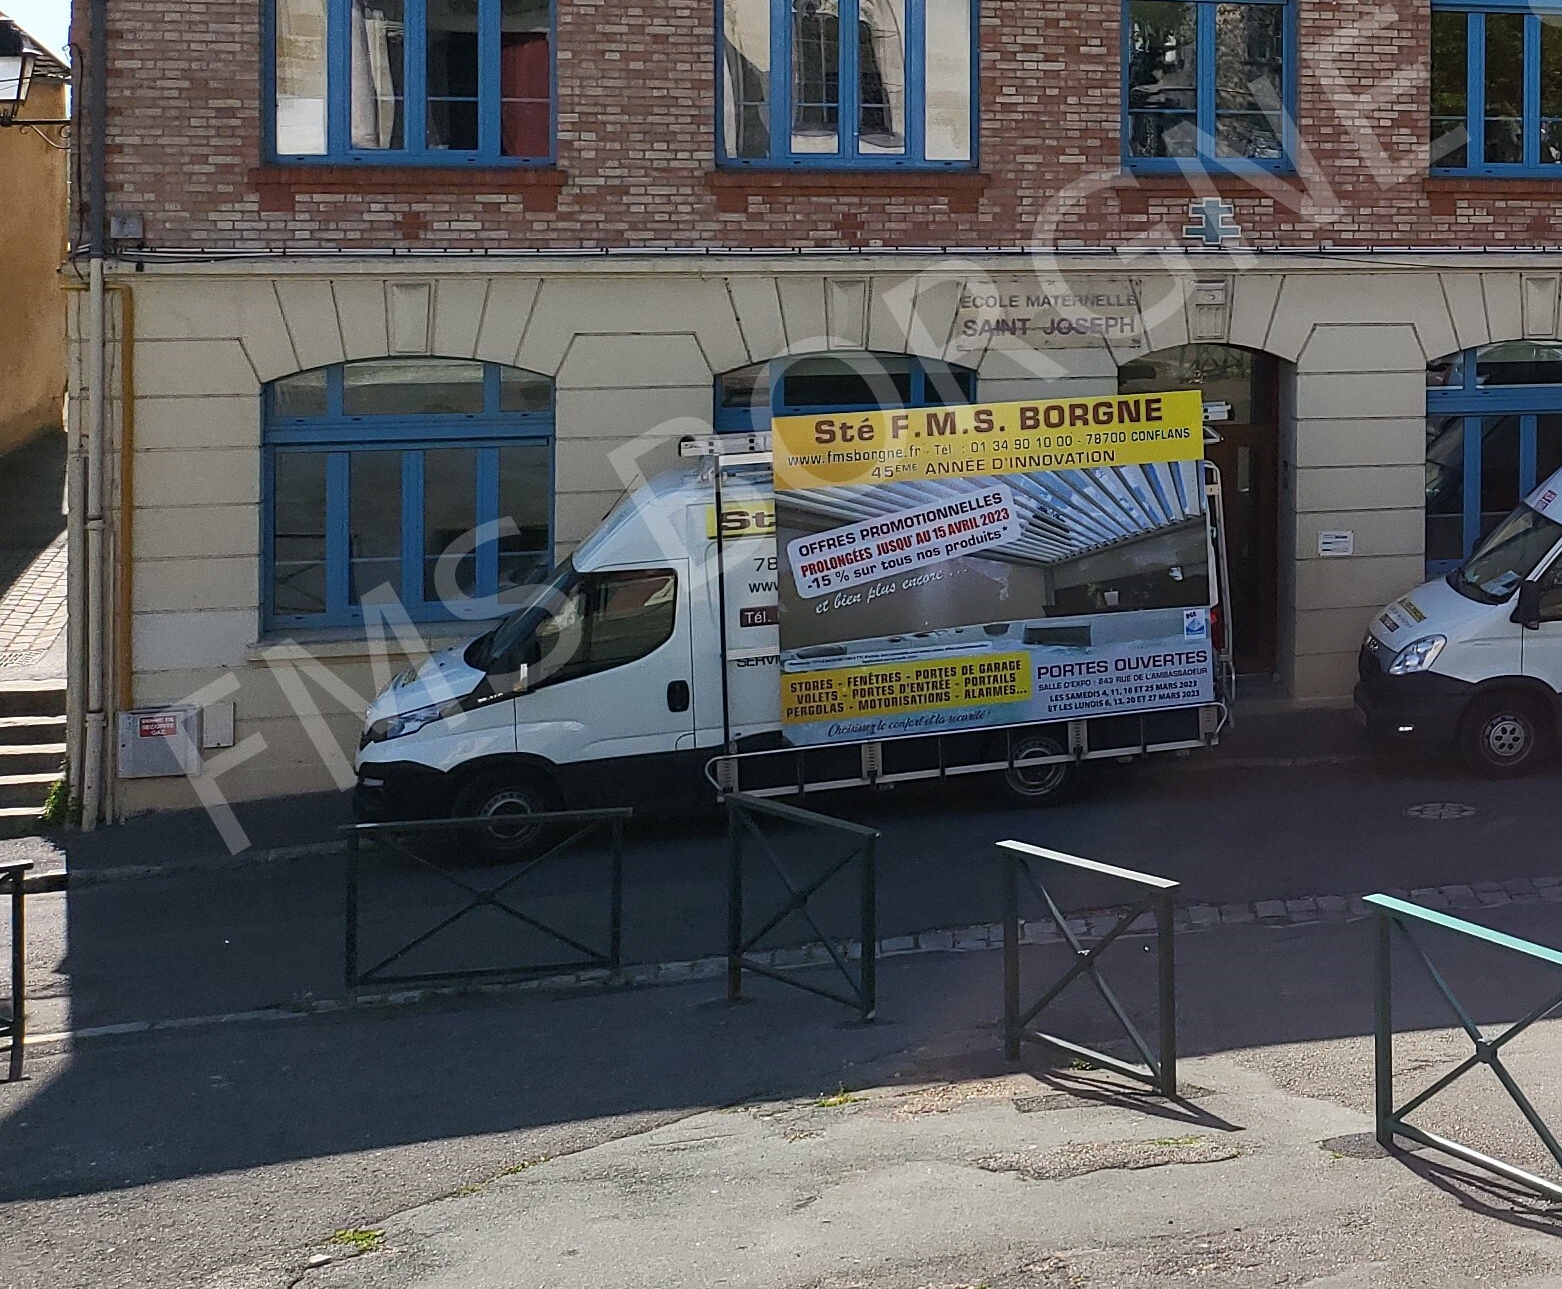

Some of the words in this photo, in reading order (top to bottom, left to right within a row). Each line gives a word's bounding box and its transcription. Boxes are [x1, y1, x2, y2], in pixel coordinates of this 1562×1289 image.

[960, 294, 1019, 309] ECOLE
[1026, 293, 1139, 309] MATERNELLE
[962, 317, 1031, 337] SAINT
[1043, 315, 1135, 336] JOSEPH
[814, 418, 875, 444] Sté
[892, 409, 1006, 439] F.M.S.
[1019, 397, 1163, 431] BORGNE
[787, 444, 921, 467] www.fmsborgne.fr
[971, 441, 986, 454] 01
[992, 440, 1008, 452] 34
[1014, 438, 1030, 450] 90
[1036, 436, 1051, 448] 10
[1056, 435, 1073, 447] 00
[1086, 431, 1127, 445] 78700
[1131, 427, 1191, 442] CONFLANS
[925, 457, 985, 475] ANNÉE
[992, 449, 1116, 470] D'INNOVATION
[721, 510, 776, 531] St
[798, 532, 856, 557] OFFRES
[860, 492, 1003, 542] PROMOTIONNELLES
[800, 547, 873, 578] PROLONGÉES
[916, 529, 932, 545] AU
[932, 526, 947, 540] 15
[947, 516, 981, 536] AVRIL
[980, 507, 1010, 527] 2023
[807, 574, 832, 589] -15
[835, 569, 850, 583] %
[853, 564, 877, 578] sur
[881, 555, 913, 570] tous
[916, 547, 941, 561] nos
[815, 599, 829, 614] et
[833, 591, 862, 609] bien
[866, 582, 896, 604] plus
[902, 570, 944, 590] encore
[744, 611, 772, 624] Tél.
[790, 678, 833, 693] STORES
[915, 666, 957, 681] PORTES
[961, 664, 975, 676] DE
[978, 660, 1022, 674] GARAGE
[1037, 660, 1109, 680] PORTES
[1114, 650, 1208, 672] OUVERTES
[796, 690, 838, 705] VOLETS
[852, 684, 895, 699] PORTES
[899, 677, 951, 694] D'ENTRÉE
[964, 672, 1016, 688] PORTAILS
[1038, 681, 1062, 692] SALLE
[1133, 673, 1144, 682] DE
[1049, 694, 1064, 702] LES
[1065, 690, 1101, 701] SAMEDIS
[1155, 682, 1178, 691] MARS
[786, 702, 845, 718] PERGOLAS
[858, 691, 951, 711] MOTORISATIONS
[1047, 704, 1058, 712] ET
[1059, 703, 1074, 711] LES
[1074, 699, 1104, 710] LUNDIS
[1136, 695, 1146, 703] ET
[1158, 691, 1181, 700] MARS
[827, 722, 876, 737] Choisissez
[888, 714, 924, 731] confort
